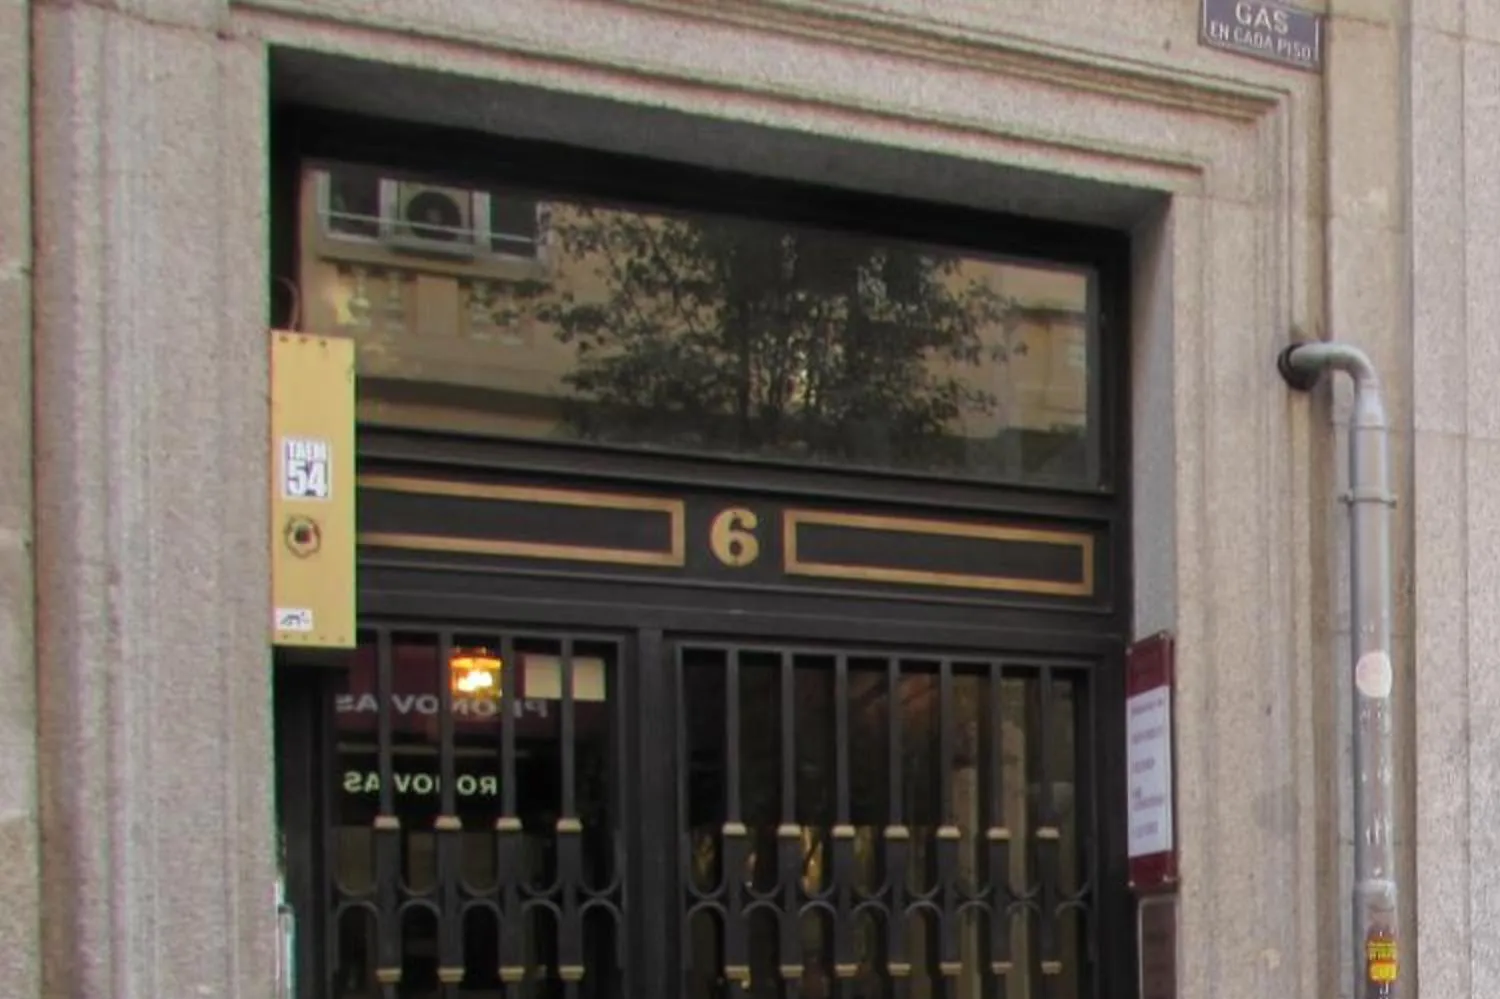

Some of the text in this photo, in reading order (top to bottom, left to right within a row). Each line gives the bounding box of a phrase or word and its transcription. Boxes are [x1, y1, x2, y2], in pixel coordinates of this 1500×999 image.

[1235, 1, 1290, 35] GAS
[1233, 26, 1275, 51] CADA
[1277, 38, 1312, 60] PISO
[710, 508, 759, 567] 6
